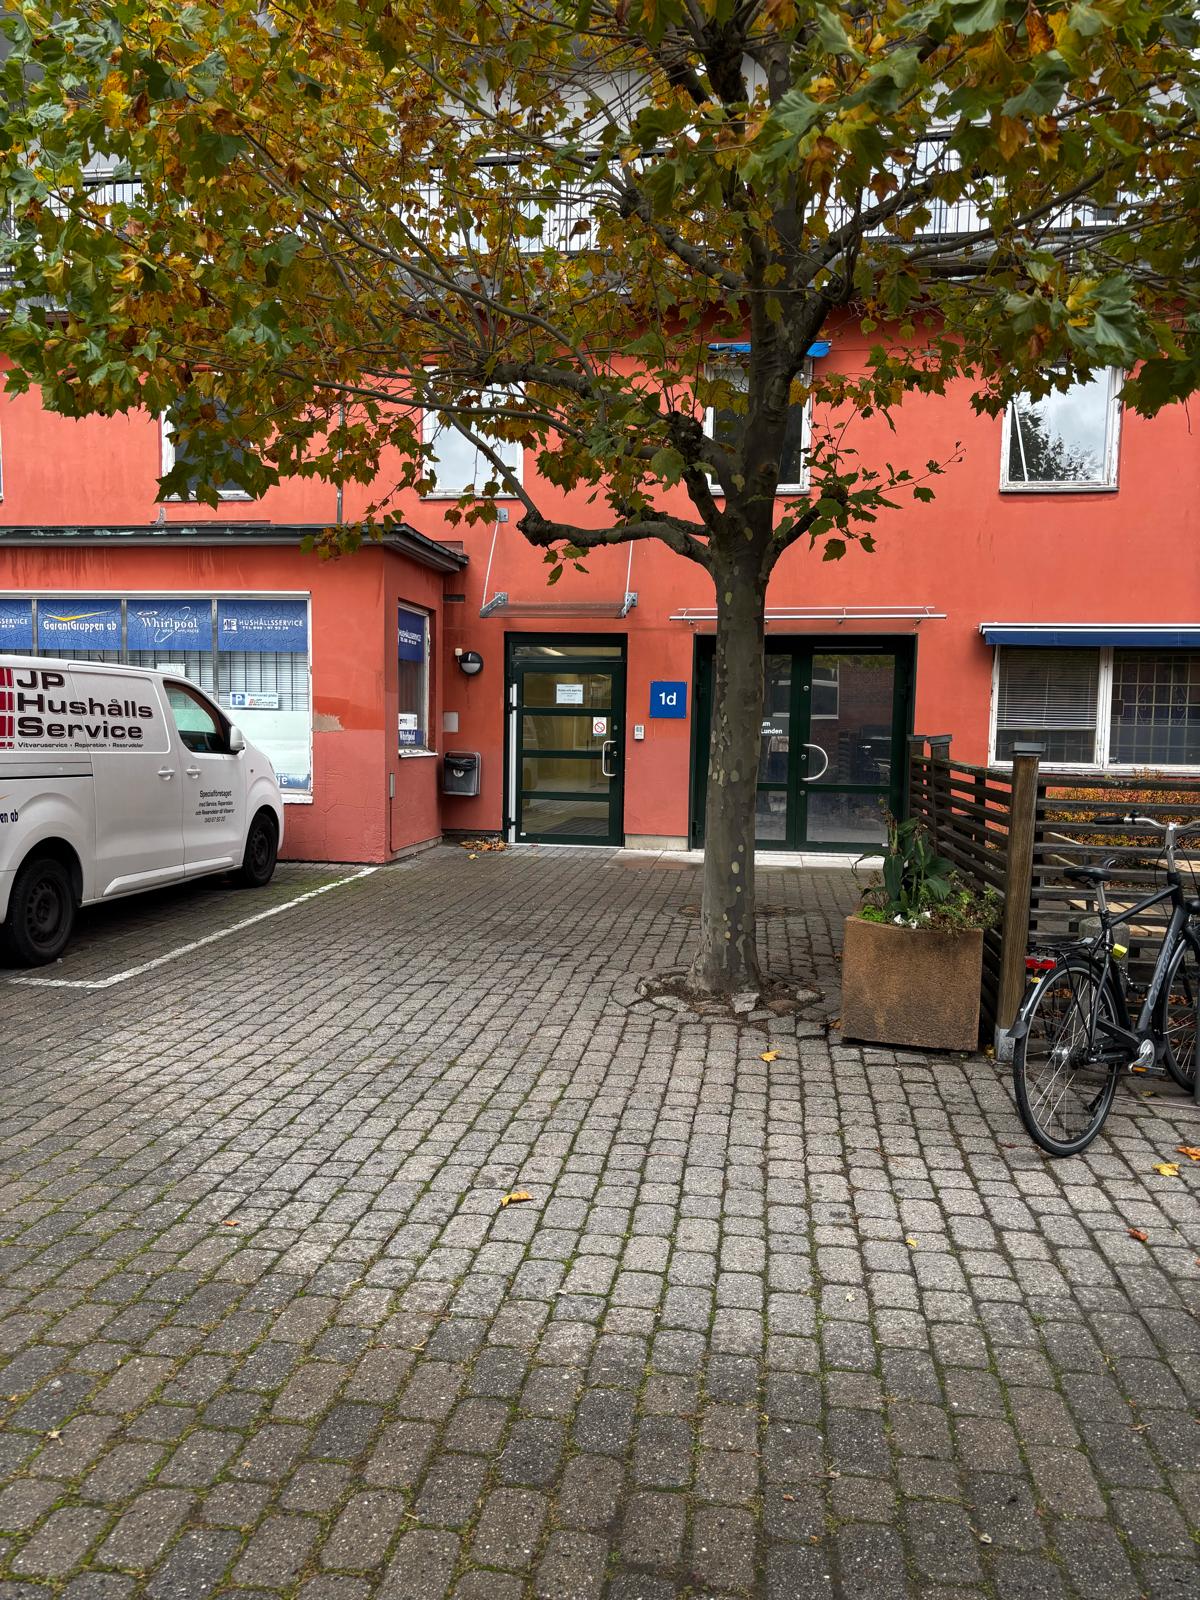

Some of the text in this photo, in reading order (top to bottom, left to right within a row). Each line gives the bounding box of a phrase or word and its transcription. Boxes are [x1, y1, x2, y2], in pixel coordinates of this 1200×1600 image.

[43, 620, 117, 633] GarantGruppen ab
[142, 617, 198, 631] Whirlpool
[238, 617, 303, 627] HUSHÅLLSSERVICE
[16, 670, 65, 690] JP
[17, 692, 153, 719] Hushålls
[659, 691, 677, 706] 1d
[17, 716, 143, 739] Service
[10, 808, 19, 823] ab
